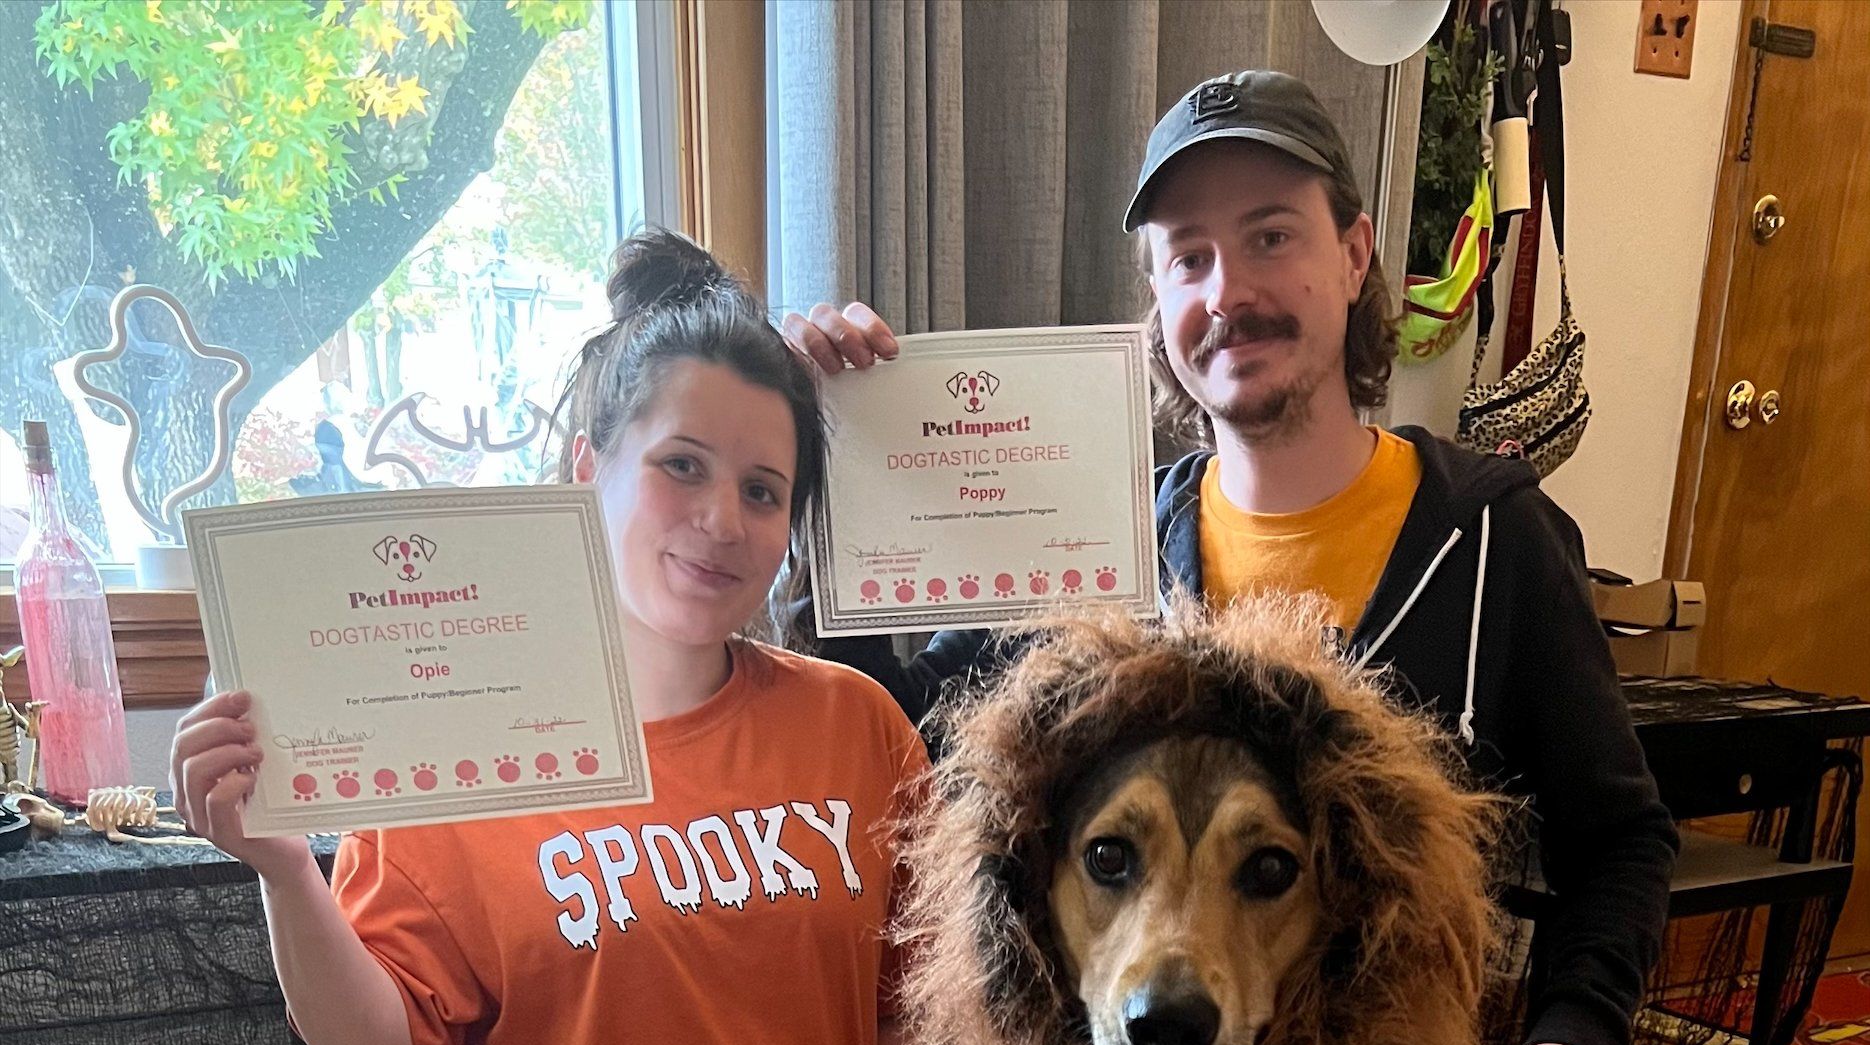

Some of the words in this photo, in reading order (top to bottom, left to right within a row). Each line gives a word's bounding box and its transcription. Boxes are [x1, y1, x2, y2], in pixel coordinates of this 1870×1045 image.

[922, 415, 1031, 438] PetImpact!
[887, 449, 991, 470] DOGTASTIC
[995, 444, 1071, 464] DEGREE
[959, 486, 1006, 502] Poppy
[910, 514, 923, 523] For
[924, 512, 963, 522] Completion
[1028, 507, 1058, 516] Program
[348, 584, 480, 609] PetImpact!
[309, 621, 435, 648] DOGTASTIC
[440, 614, 529, 638] DEGREE
[405, 646, 413, 654] is
[414, 646, 438, 656] given
[438, 644, 448, 653] to
[409, 661, 451, 682] Opie
[345, 697, 360, 706] For
[361, 693, 410, 706] Completion
[411, 692, 420, 701] of
[486, 683, 522, 695] Program
[538, 799, 863, 951] SPOOKY
